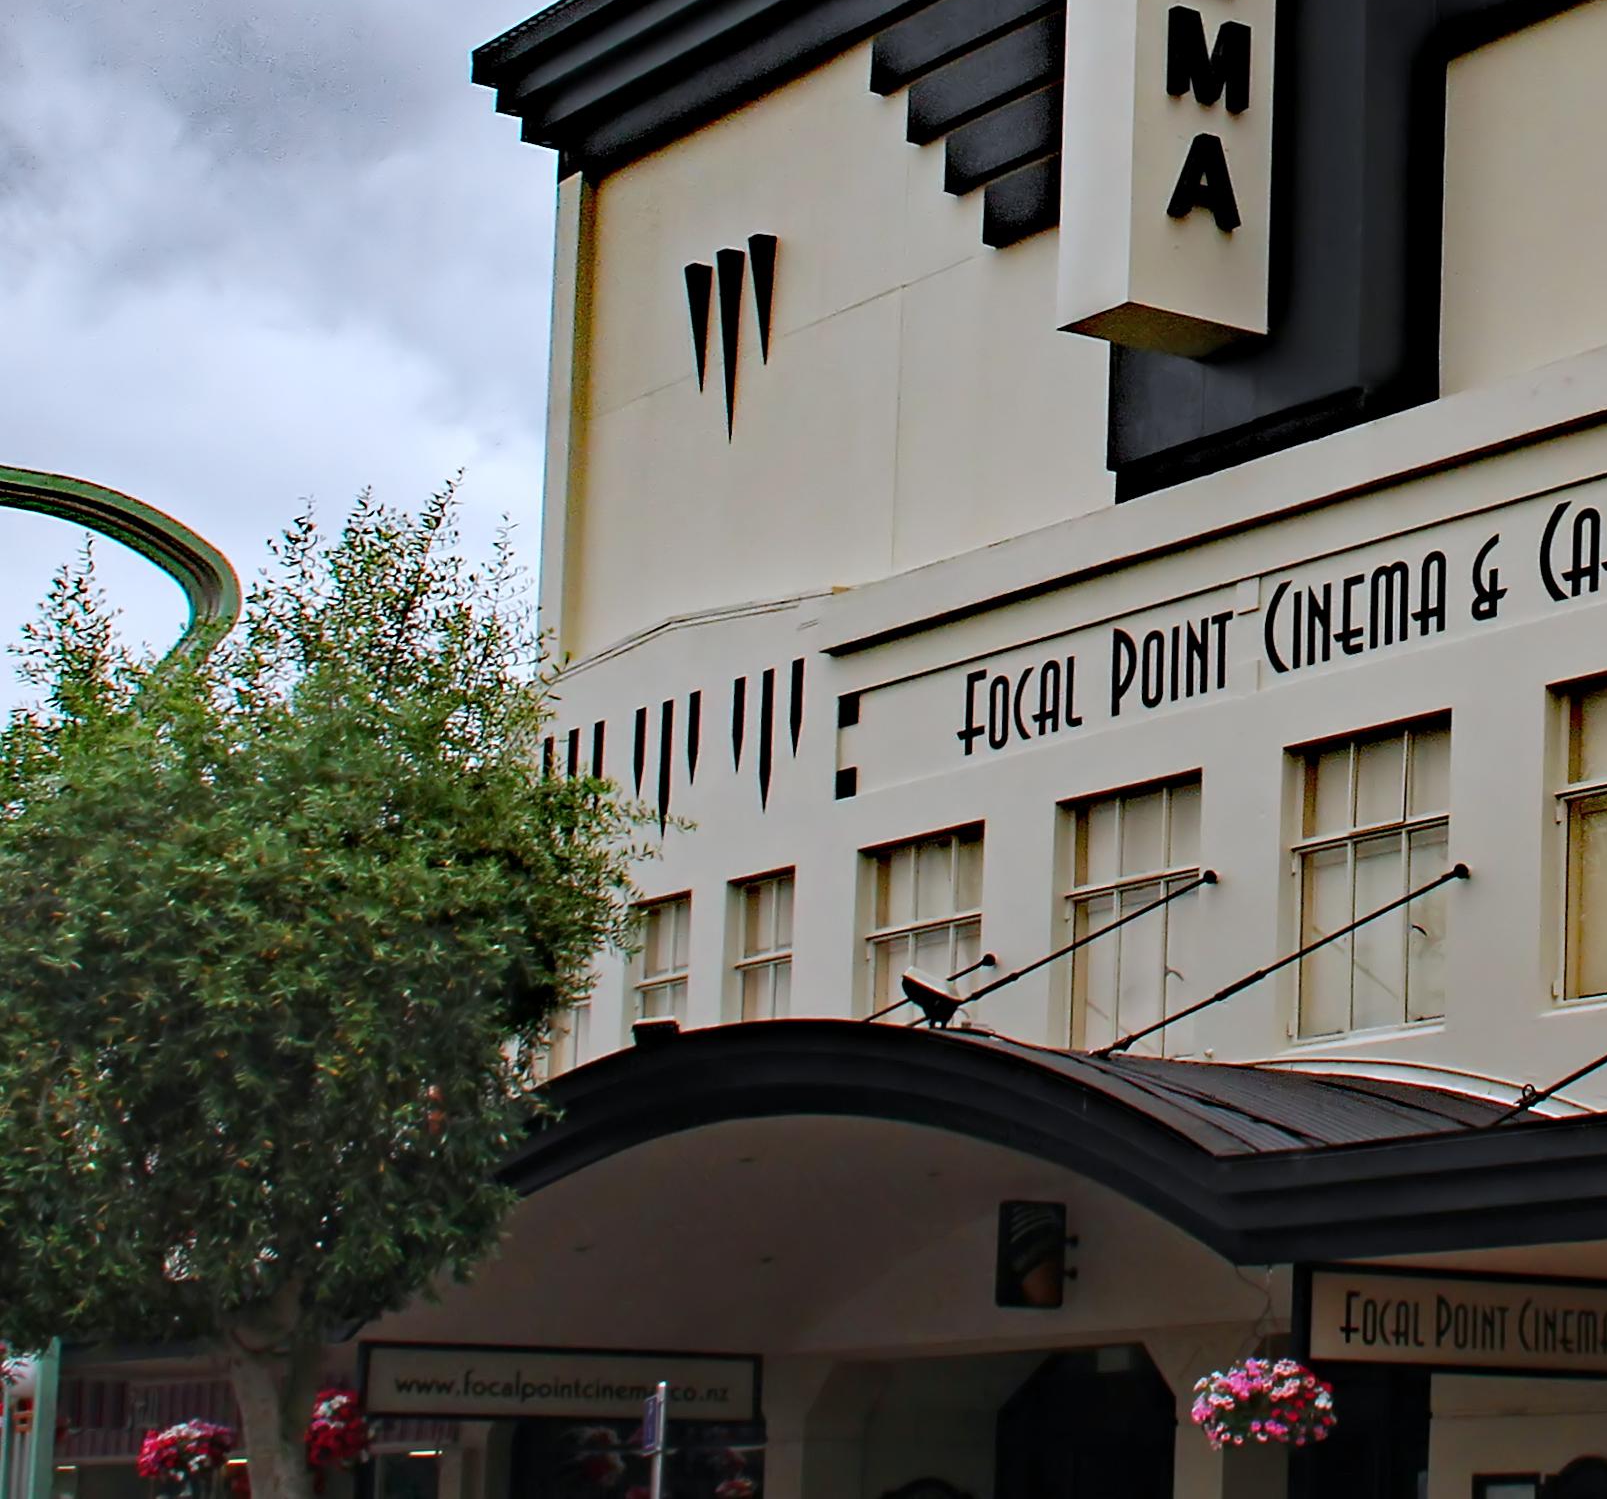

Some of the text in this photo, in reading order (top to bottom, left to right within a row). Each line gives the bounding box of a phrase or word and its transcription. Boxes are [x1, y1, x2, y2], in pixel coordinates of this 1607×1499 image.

[957, 655, 1083, 756] FOCAL
[1111, 610, 1234, 717] POINT
[1264, 549, 1447, 674] CINEMA
[1470, 533, 1508, 622] &
[1339, 1290, 1425, 1348] FOCAL
[1435, 1294, 1510, 1351] POINT
[395, 1369, 730, 1404] www.focalpointcinemco.nz
